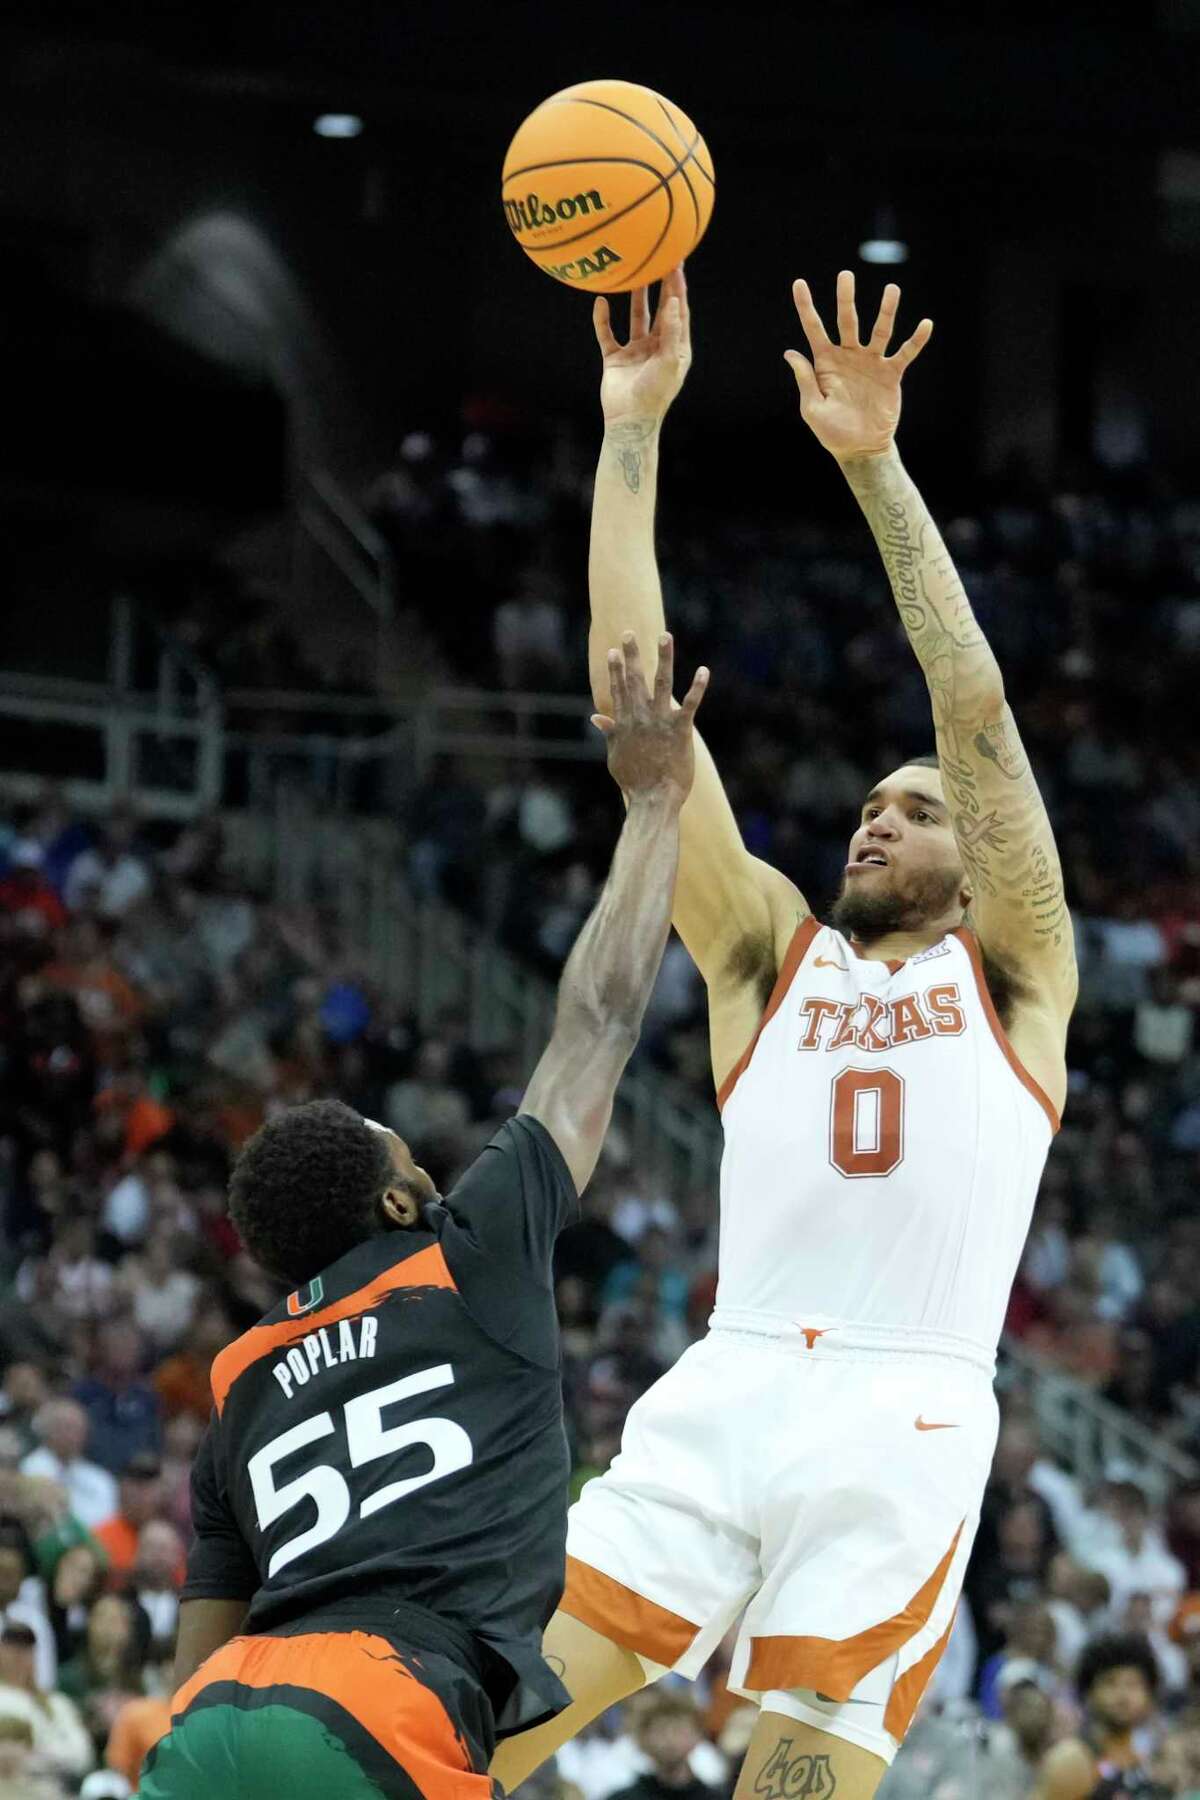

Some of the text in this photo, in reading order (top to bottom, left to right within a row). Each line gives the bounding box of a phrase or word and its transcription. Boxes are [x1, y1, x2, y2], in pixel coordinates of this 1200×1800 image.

[798, 983, 967, 1052] TEXAS
[829, 1065, 905, 1179] 0
[272, 1316, 378, 1399] POPLAR
[247, 1363, 473, 1579] 55
